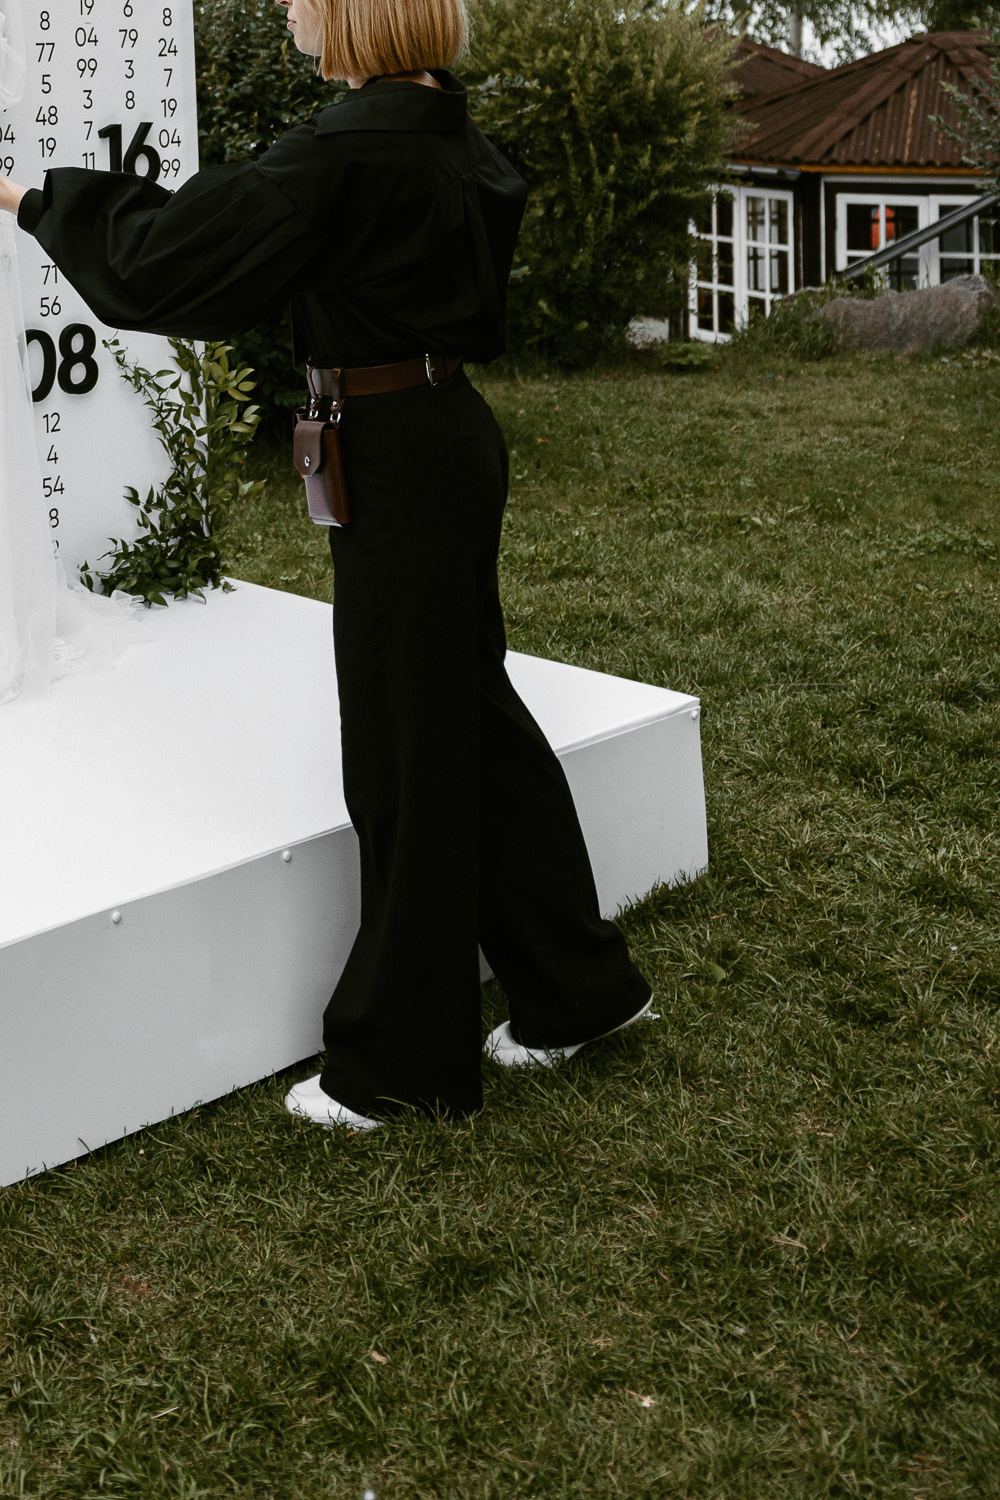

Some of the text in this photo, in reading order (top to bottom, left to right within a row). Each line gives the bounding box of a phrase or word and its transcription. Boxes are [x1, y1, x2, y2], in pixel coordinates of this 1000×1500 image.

[124, 0, 133, 17] 6
[163, 8, 172, 26] 8
[40, 11, 50, 30] 8
[75, 27, 98, 47] 04
[119, 29, 138, 48] 79
[36, 43, 55, 62] 77
[158, 38, 178, 57] 24
[77, 58, 97, 78] 99
[125, 60, 134, 78] 3
[42, 74, 51, 94] 5
[164, 69, 172, 87] 7
[83, 90, 92, 109] 3
[126, 90, 136, 109] 8
[161, 98, 177, 117] 19
[36, 106, 58, 125] 48
[83, 121, 92, 140] 7
[159, 129, 181, 148] 04
[39, 137, 56, 157] 19
[98, 122, 160, 183] 16
[82, 152, 95, 171] 11
[161, 159, 180, 178] 99
[41, 265, 59, 285] 71
[40, 296, 61, 317] 56
[17, 323, 99, 403] 08
[43, 412, 60, 433] 12
[47, 445, 58, 464] 4
[43, 476, 64, 497] 54
[49, 508, 59, 528] 8
